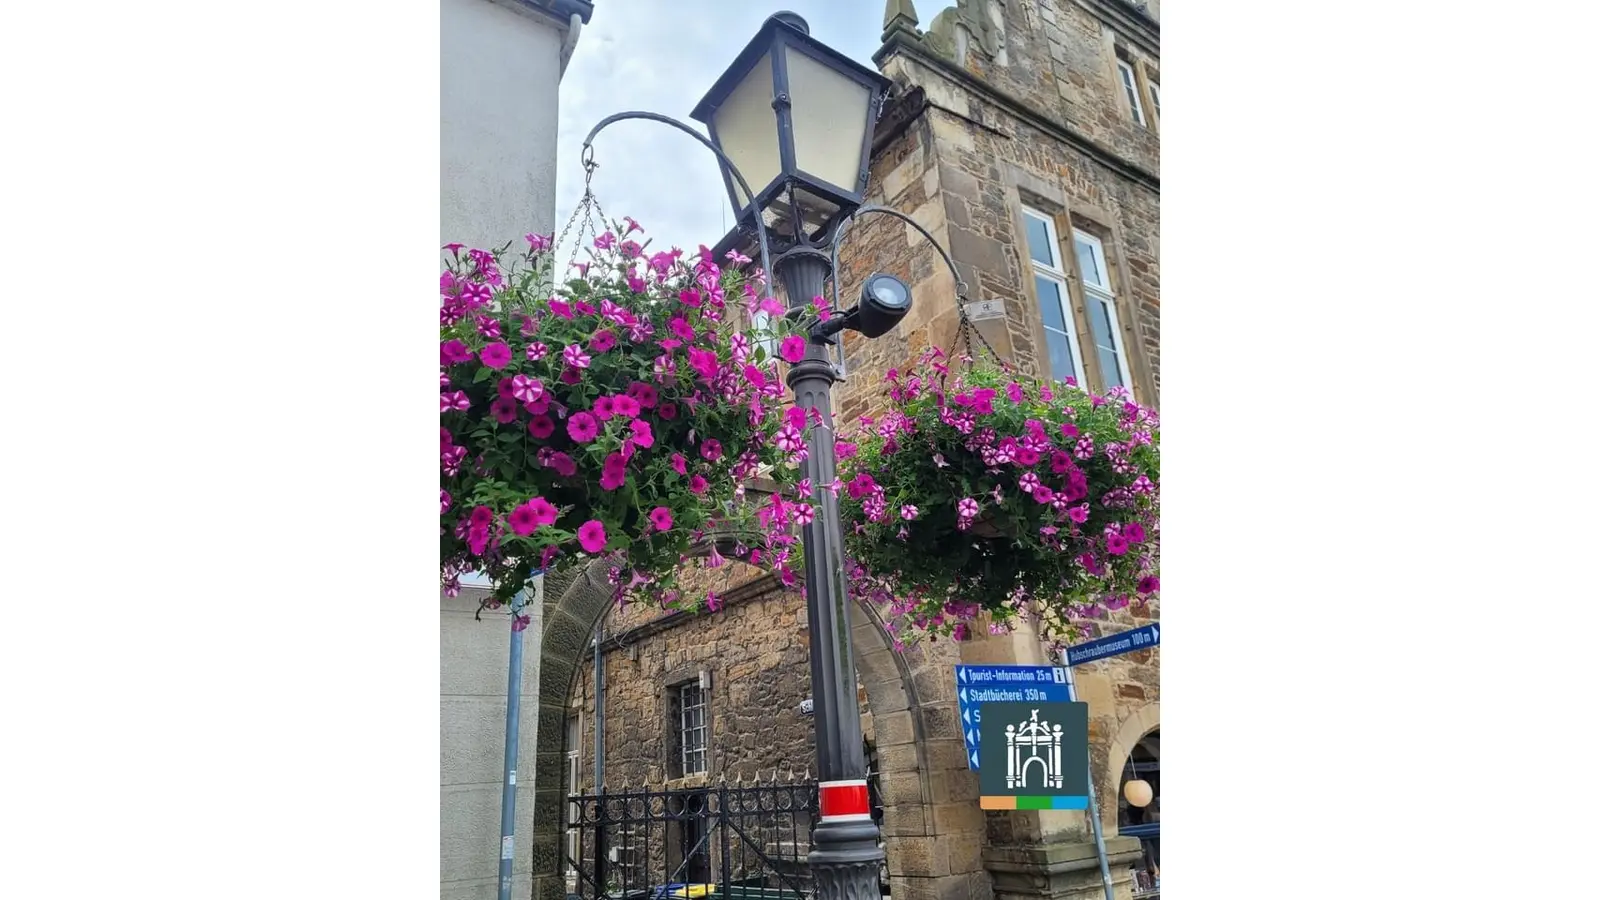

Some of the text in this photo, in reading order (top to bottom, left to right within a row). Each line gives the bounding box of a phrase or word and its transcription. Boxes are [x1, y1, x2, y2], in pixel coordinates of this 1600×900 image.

[1070, 632, 1151, 660] Hubschraubermuseum 100 m
[968, 669, 1035, 681] Tourist-Information
[1036, 669, 1045, 681] 25
[1045, 673, 1051, 681] m
[970, 689, 1046, 702] Stadtbücherei 350 m
